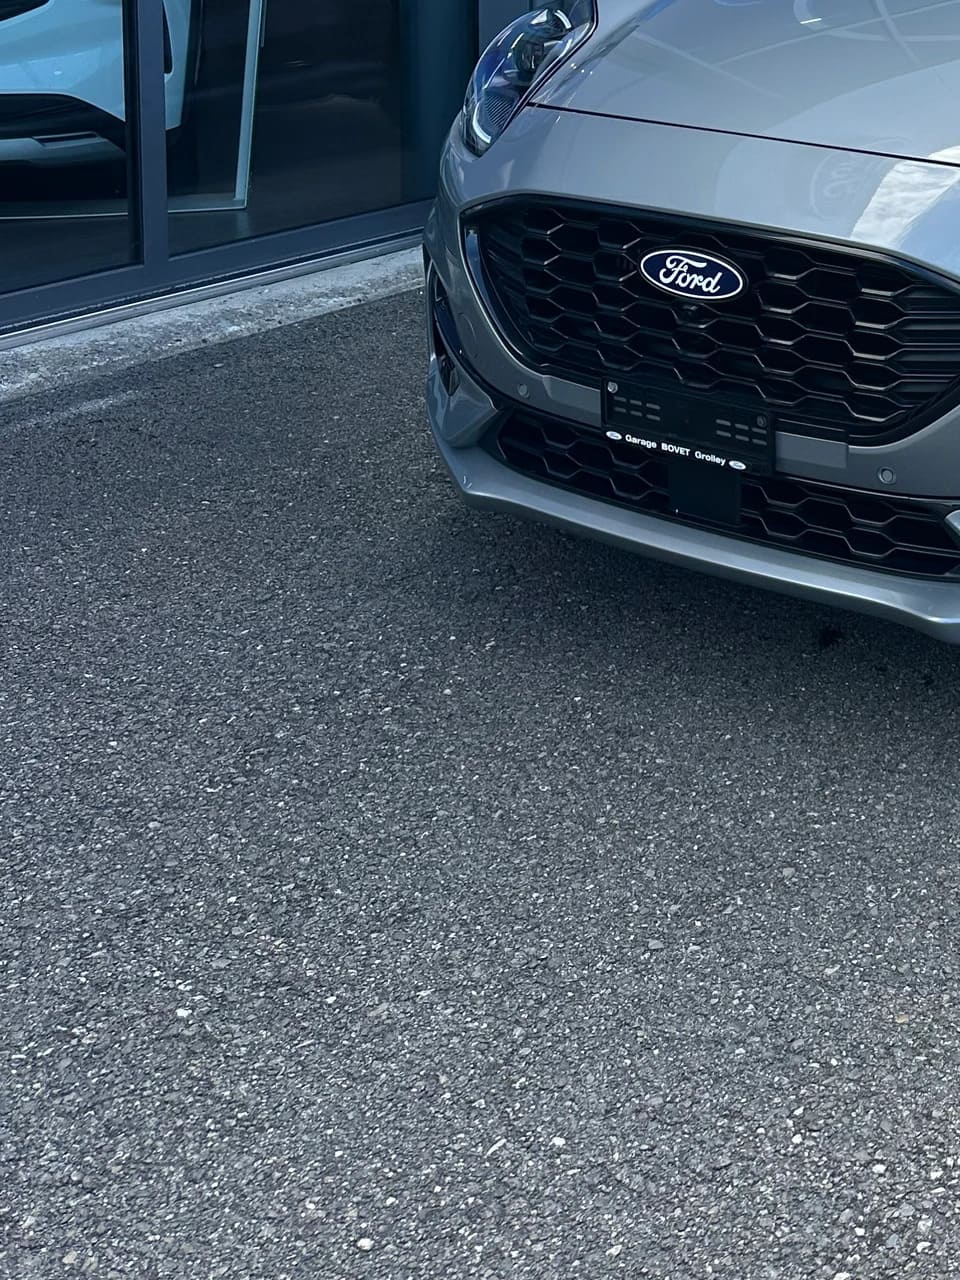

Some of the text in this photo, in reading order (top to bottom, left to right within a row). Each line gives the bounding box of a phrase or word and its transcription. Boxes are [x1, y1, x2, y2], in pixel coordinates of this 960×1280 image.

[659, 255, 723, 294] Ford
[625, 434, 657, 449] Garage
[661, 442, 691, 457] BOVET
[694, 451, 726, 467] Grolley
